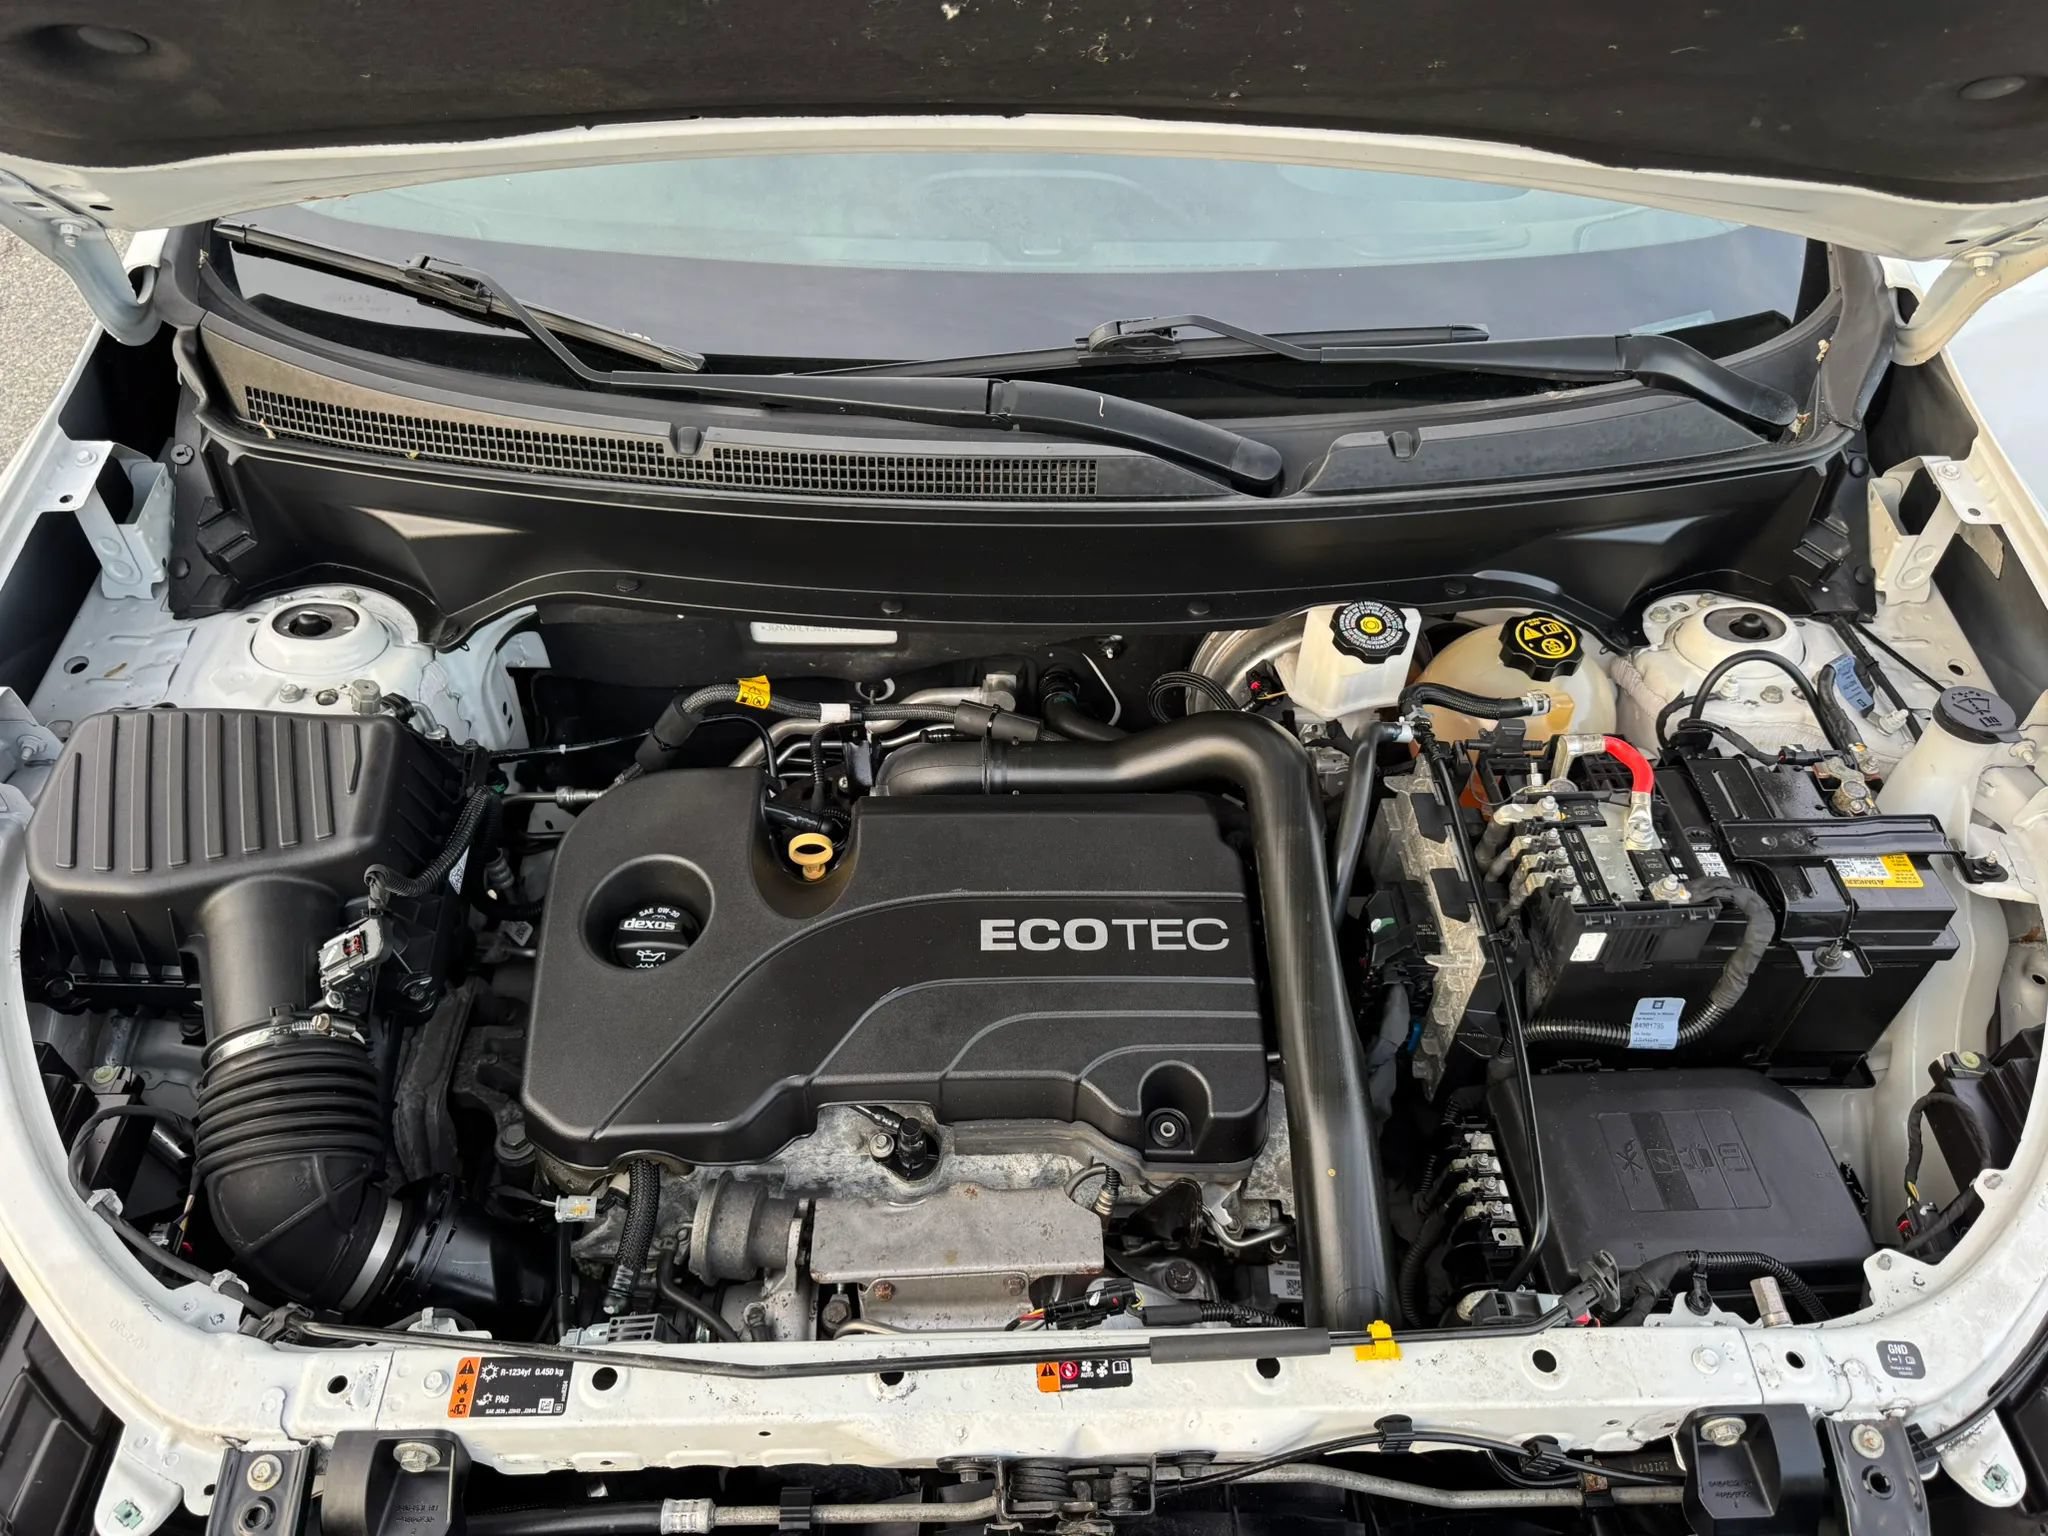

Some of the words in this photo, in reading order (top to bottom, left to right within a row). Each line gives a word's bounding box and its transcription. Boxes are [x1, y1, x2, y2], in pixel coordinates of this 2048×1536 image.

[639, 908, 655, 917] SAE
[657, 907, 681, 918] 0W-20
[623, 917, 678, 931] dexos
[980, 918, 1230, 951] ECOTEC
[1887, 1343, 1908, 1355] GND
[500, 1368, 532, 1377] R-1234yf
[535, 1368, 554, 1376] 0.450
[555, 1368, 564, 1377] kg
[495, 1395, 510, 1403] PAG
